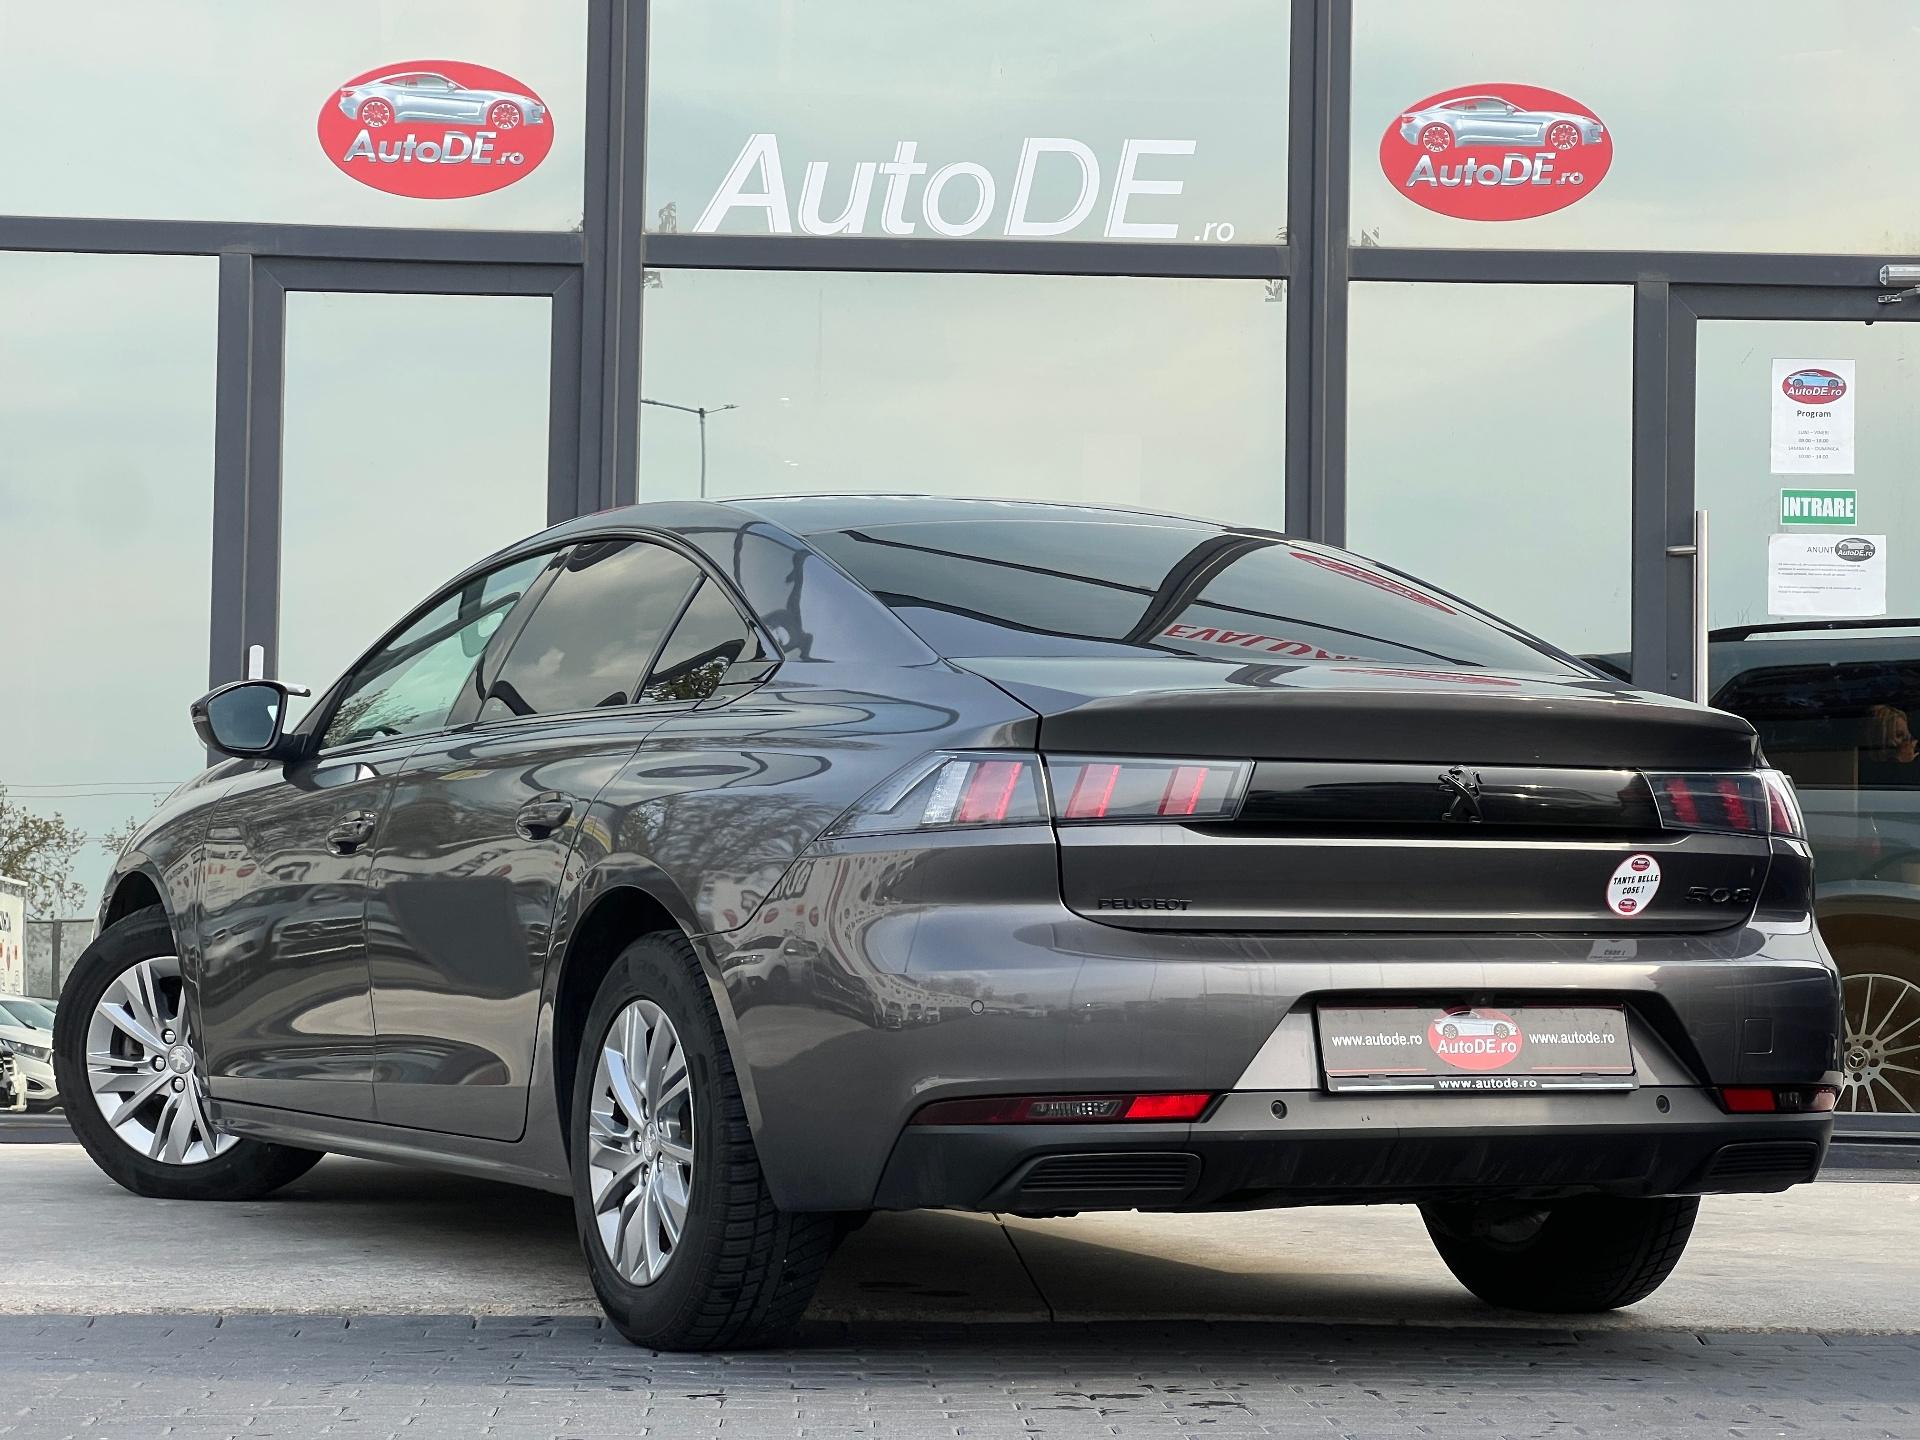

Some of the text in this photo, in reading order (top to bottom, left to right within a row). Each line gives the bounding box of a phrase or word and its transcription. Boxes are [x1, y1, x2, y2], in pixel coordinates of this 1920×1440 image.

[1787, 385, 1842, 396] AutoDE.ro
[1796, 410, 1832, 419] Program
[1783, 497, 1855, 518] INTRARE
[1837, 549, 1873, 557] AutoDE.ro
[1613, 874, 1659, 885] TANTE BELLE
[1622, 886, 1640, 895] COSE
[1097, 897, 1192, 910] PEUGEOT
[1331, 1031, 1615, 1054] www.autode.ro AutoDE.ro www.autode.ro
[1438, 1077, 1537, 1089] www.autode.ro
